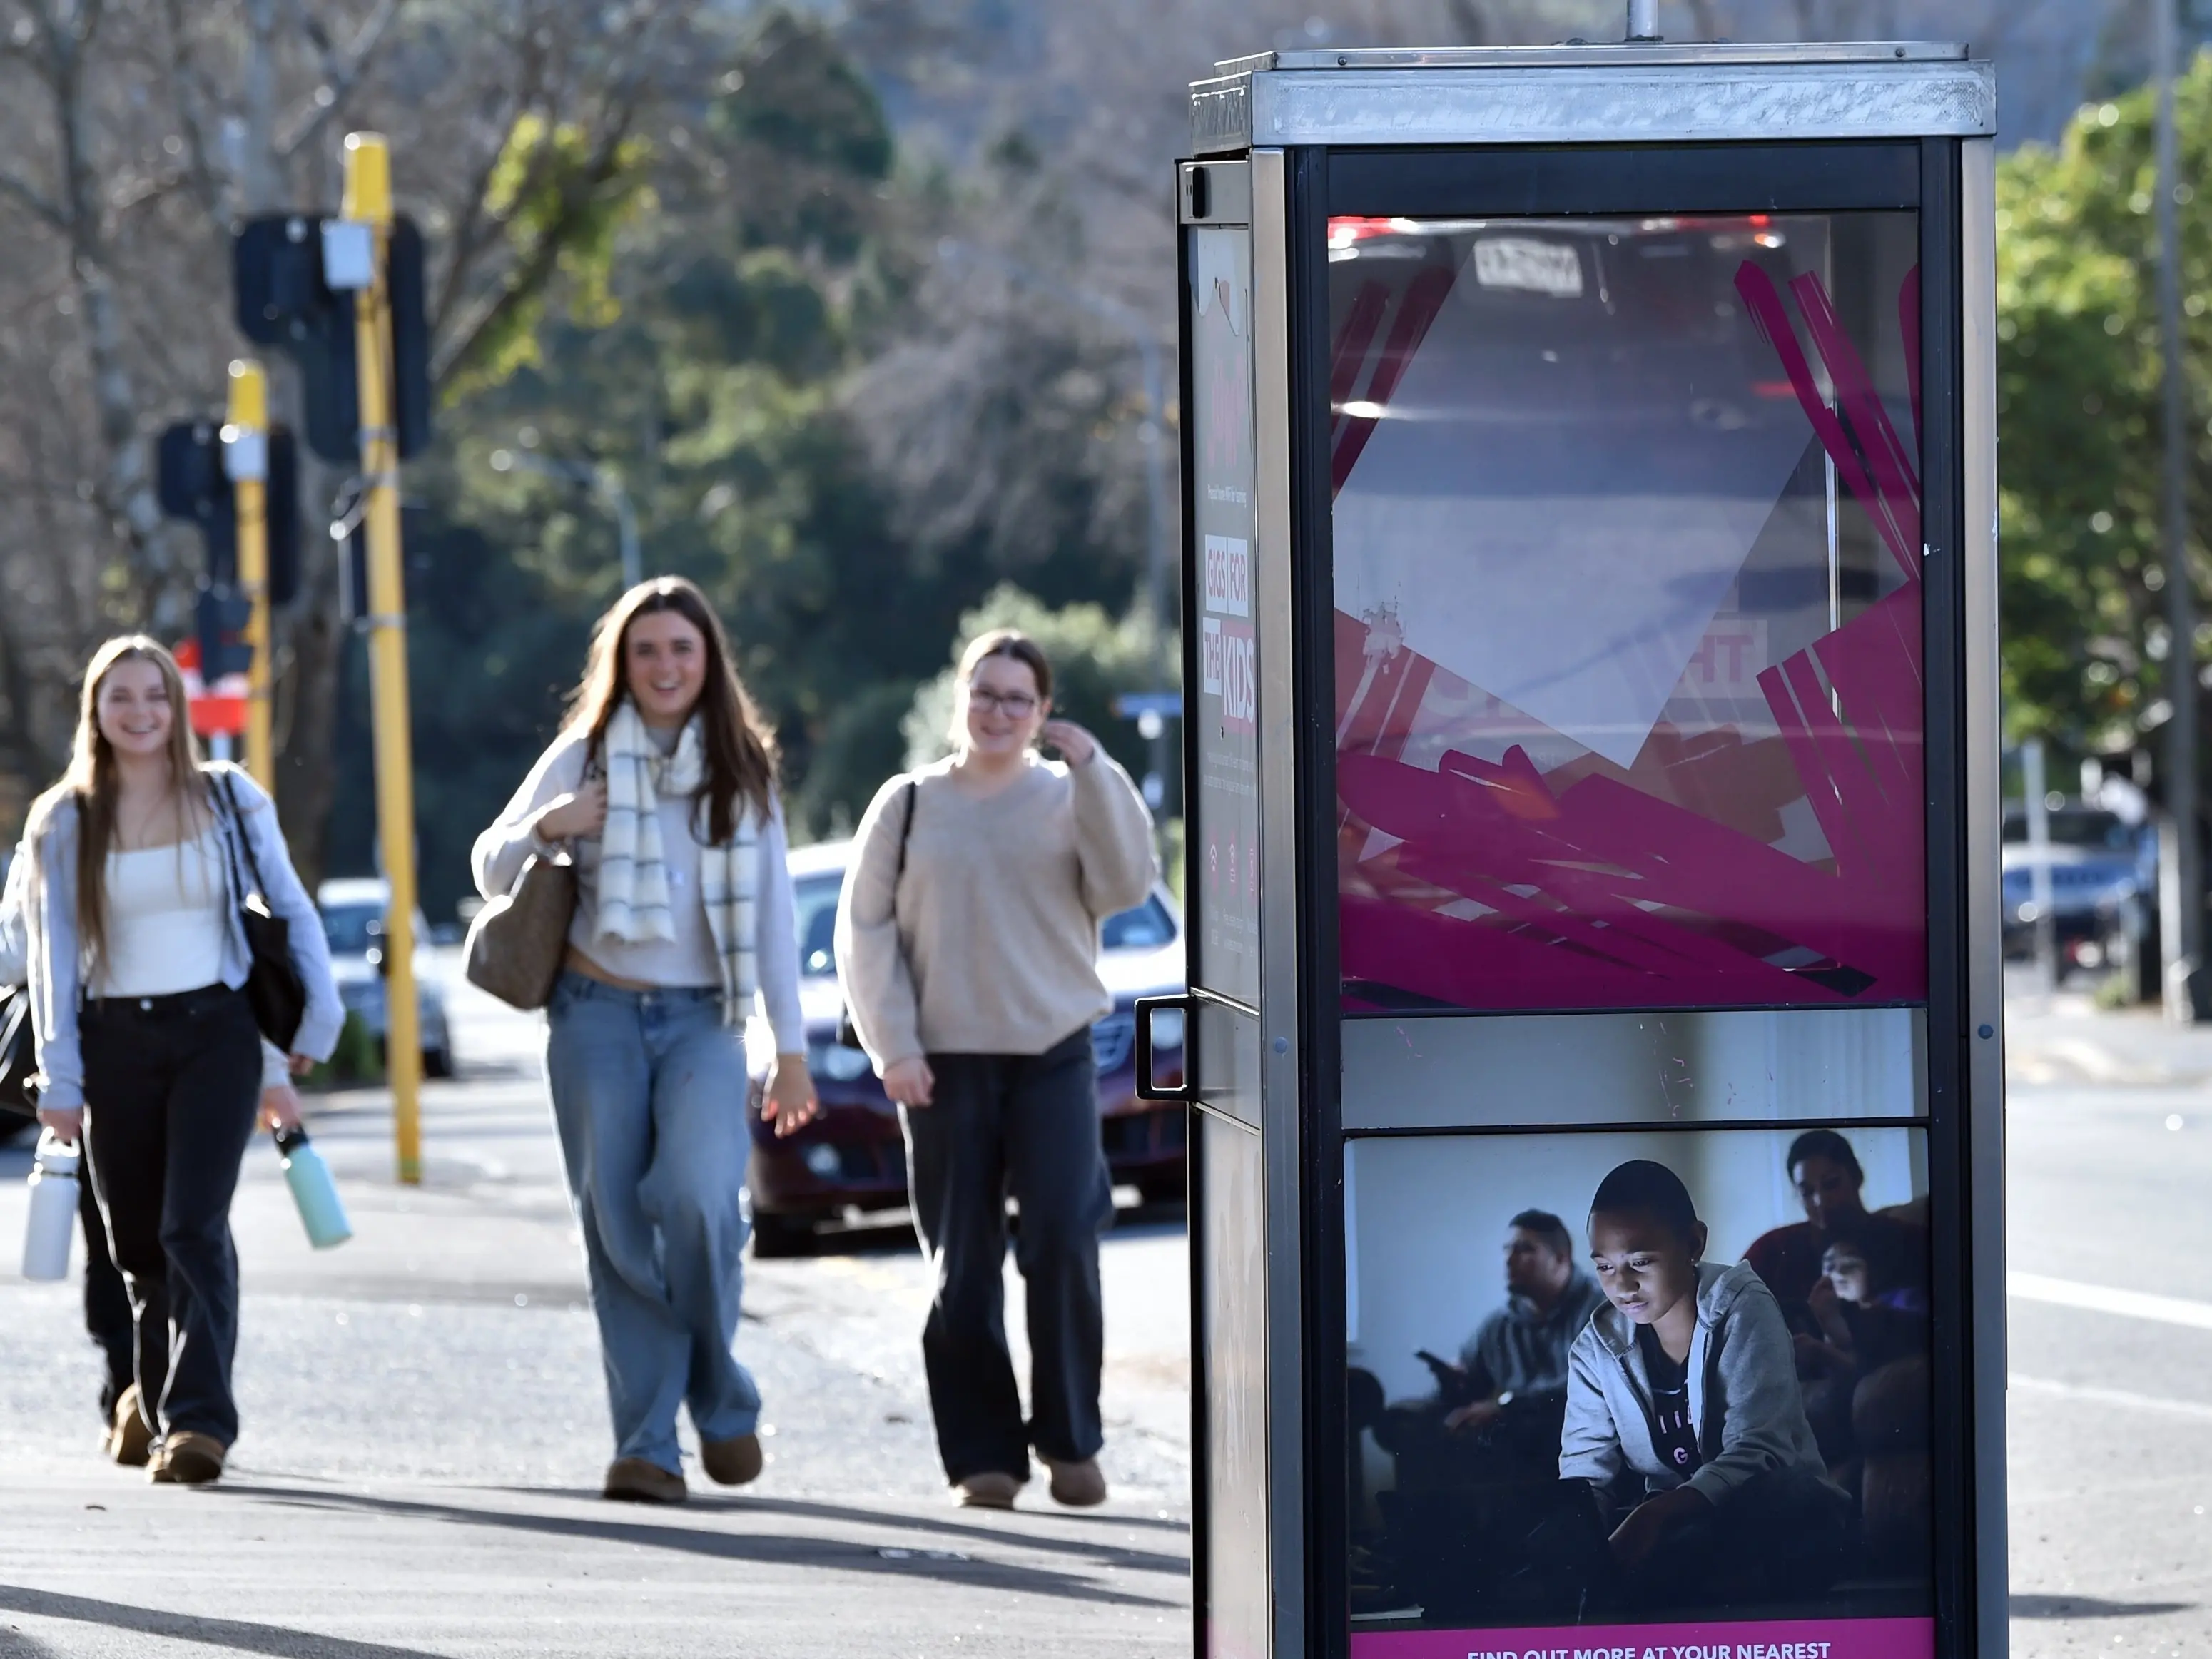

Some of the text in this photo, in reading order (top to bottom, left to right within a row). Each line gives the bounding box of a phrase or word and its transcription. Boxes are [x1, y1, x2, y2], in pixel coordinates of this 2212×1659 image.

[1208, 549, 1246, 602] GIGS FOR
[1204, 632, 1255, 724] THE KIDS
[1573, 1648, 1636, 1659] MORE
[1642, 1647, 1668, 1659] AT
[1671, 1645, 1731, 1659] YOUR
[1737, 1643, 1831, 1659] NEAREST
